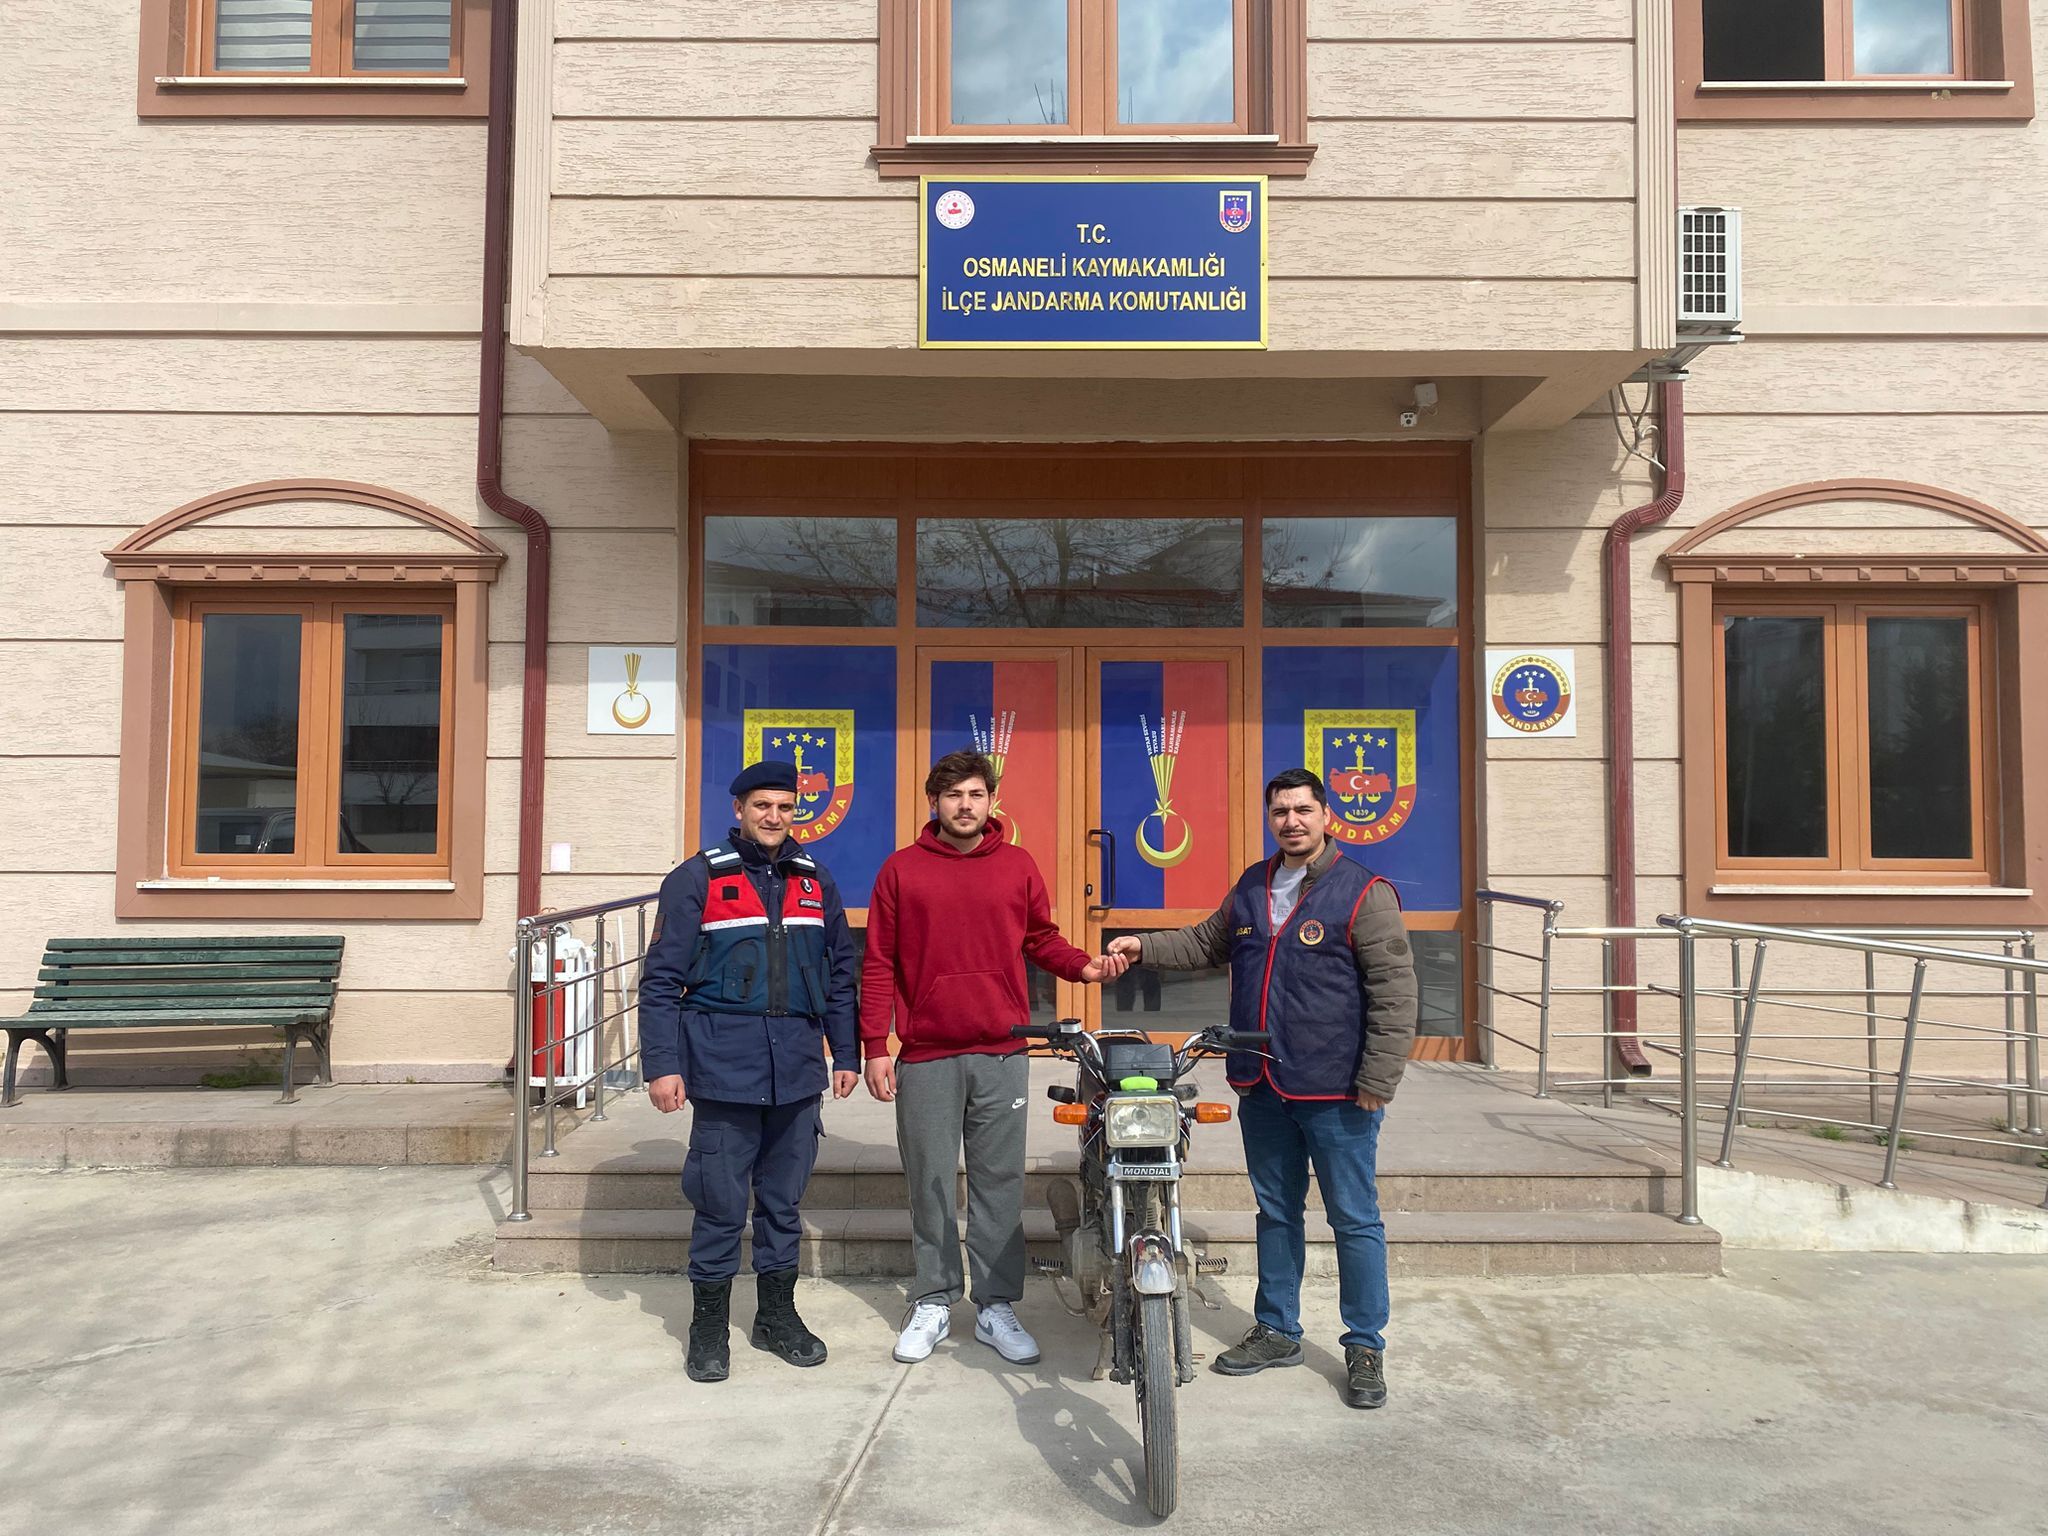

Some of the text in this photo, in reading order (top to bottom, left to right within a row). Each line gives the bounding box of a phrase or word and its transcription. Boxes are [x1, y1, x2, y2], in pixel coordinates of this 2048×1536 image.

[1077, 223, 1111, 244] T.C.
[963, 252, 1225, 277] OSMANELİ KAYMAKAMLIĞI
[942, 286, 1246, 315] İLÇE JANDARMA KOMUTANLIĞI
[1502, 711, 1562, 731] JANDARMA
[1352, 809, 1369, 817] 1839
[1124, 1167, 1170, 1176] MONDIAL
